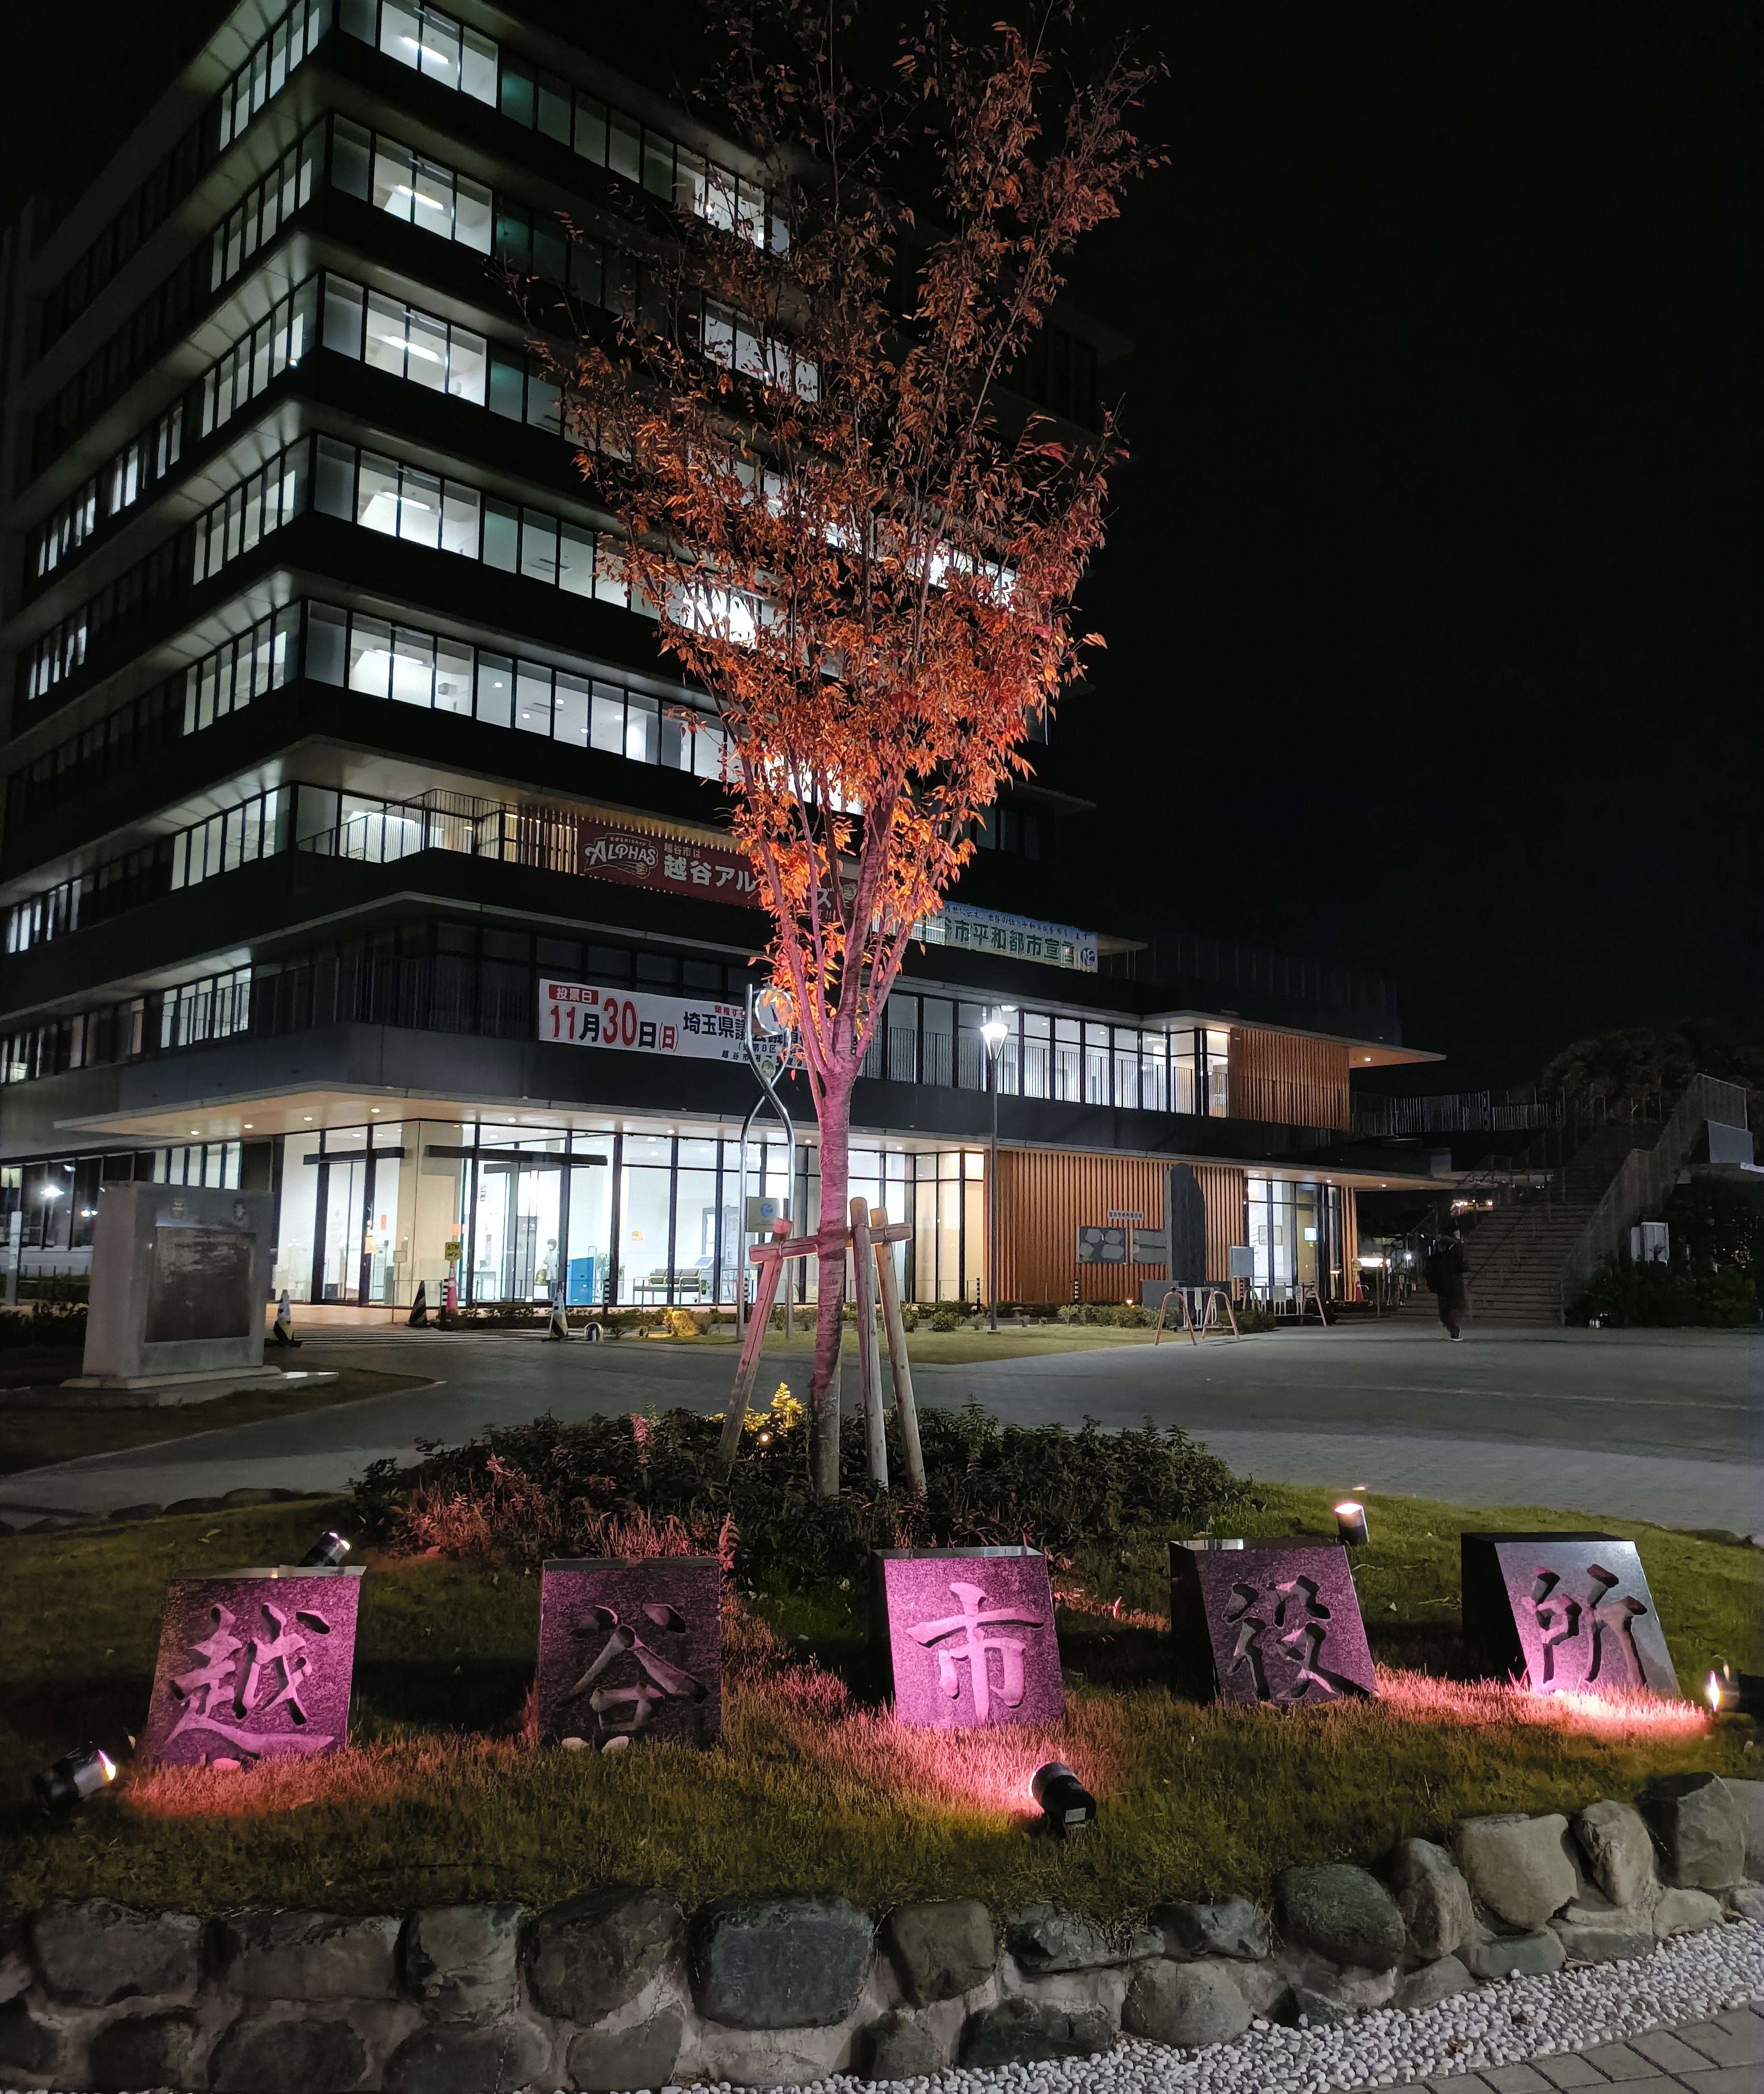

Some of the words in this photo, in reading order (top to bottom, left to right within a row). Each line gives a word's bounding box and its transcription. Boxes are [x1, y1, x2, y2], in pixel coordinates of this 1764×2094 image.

[585, 841, 657, 866] ALPHAS
[664, 842, 701, 859] 越谷市は
[556, 987, 592, 1004] 投票日
[165, 1602, 334, 1760] 越
[560, 1603, 710, 1731] 谷
[905, 1581, 1044, 1725] 市
[1221, 1574, 1380, 1700] 役
[1521, 1564, 1648, 1691] 所
